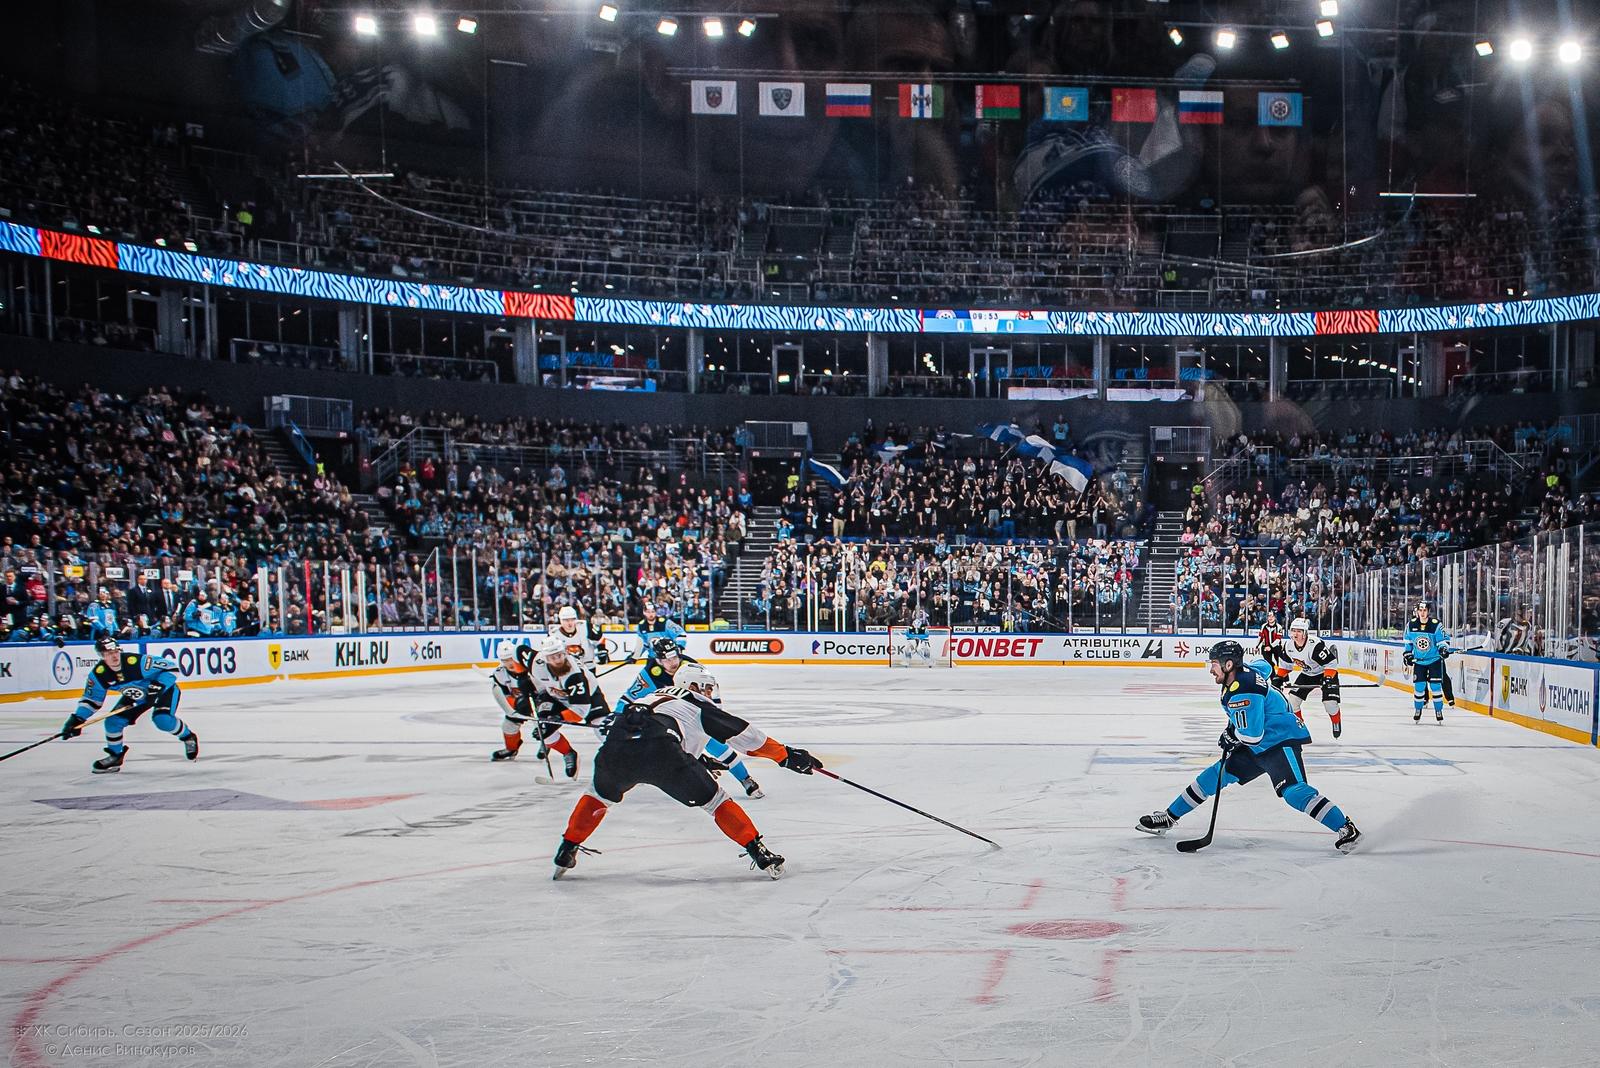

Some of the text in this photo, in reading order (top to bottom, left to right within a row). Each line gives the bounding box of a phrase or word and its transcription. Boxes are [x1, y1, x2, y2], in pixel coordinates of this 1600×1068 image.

[421, 640, 442, 660] сбп
[714, 640, 769, 652] WINLINE
[941, 638, 1043, 657] FONBET
[1063, 638, 1141, 648] ATRIBUTIKA
[283, 649, 309, 662] БАНК
[335, 641, 389, 667] KHL.RU
[1073, 650, 1120, 659] & CLUB
[567, 681, 586, 697] 73
[1510, 676, 1528, 697] БАНК
[1548, 684, 1590, 716] ТЕХНОПАН
[1235, 710, 1248, 729] 11
